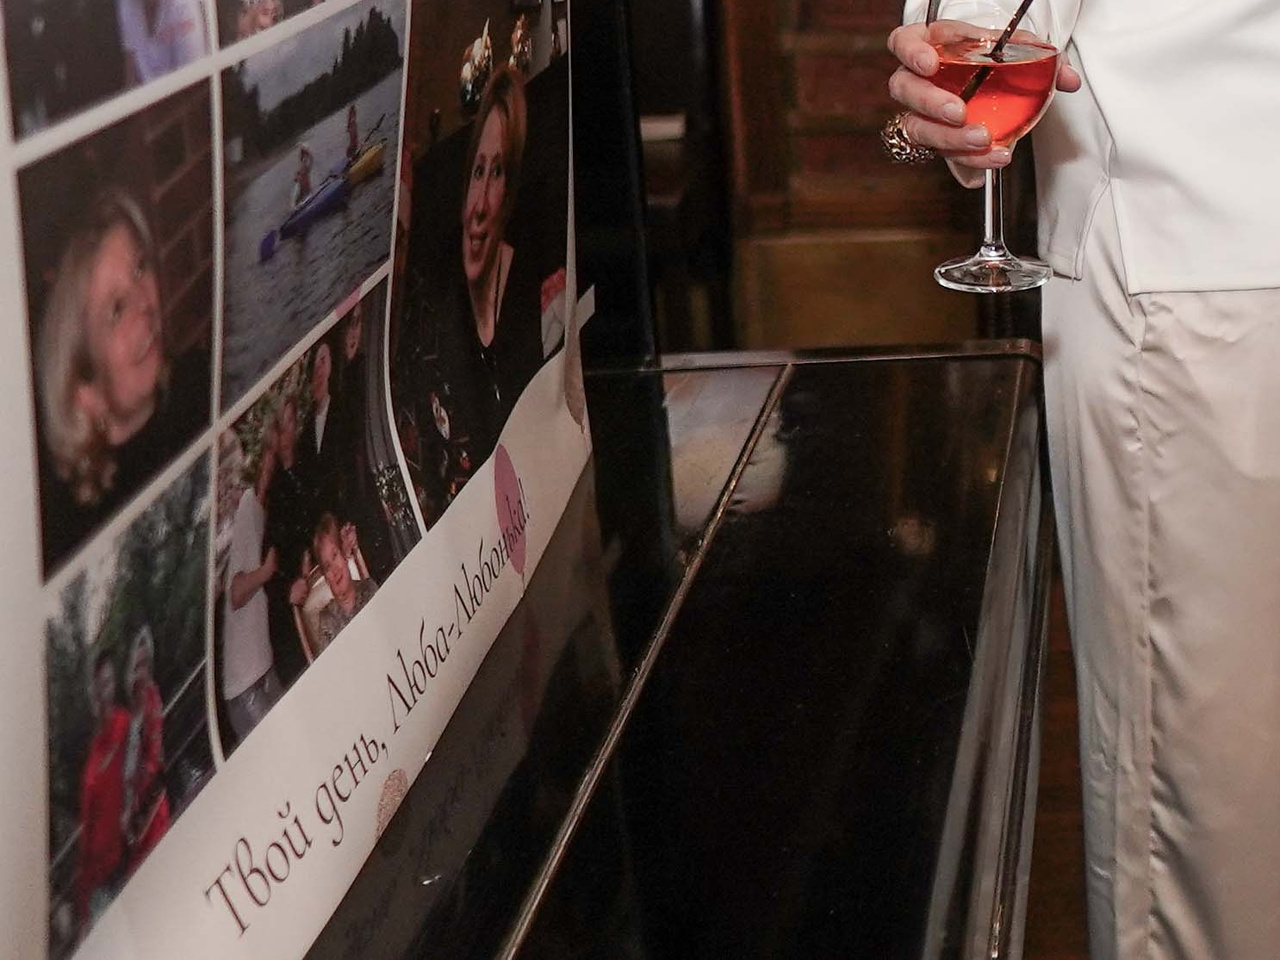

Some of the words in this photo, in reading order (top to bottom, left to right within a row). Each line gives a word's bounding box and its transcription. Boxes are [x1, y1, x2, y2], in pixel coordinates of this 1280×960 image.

[205, 801, 312, 938] Твой
[314, 732, 388, 847] день,
[386, 478, 530, 733] Люба-Любонька!
